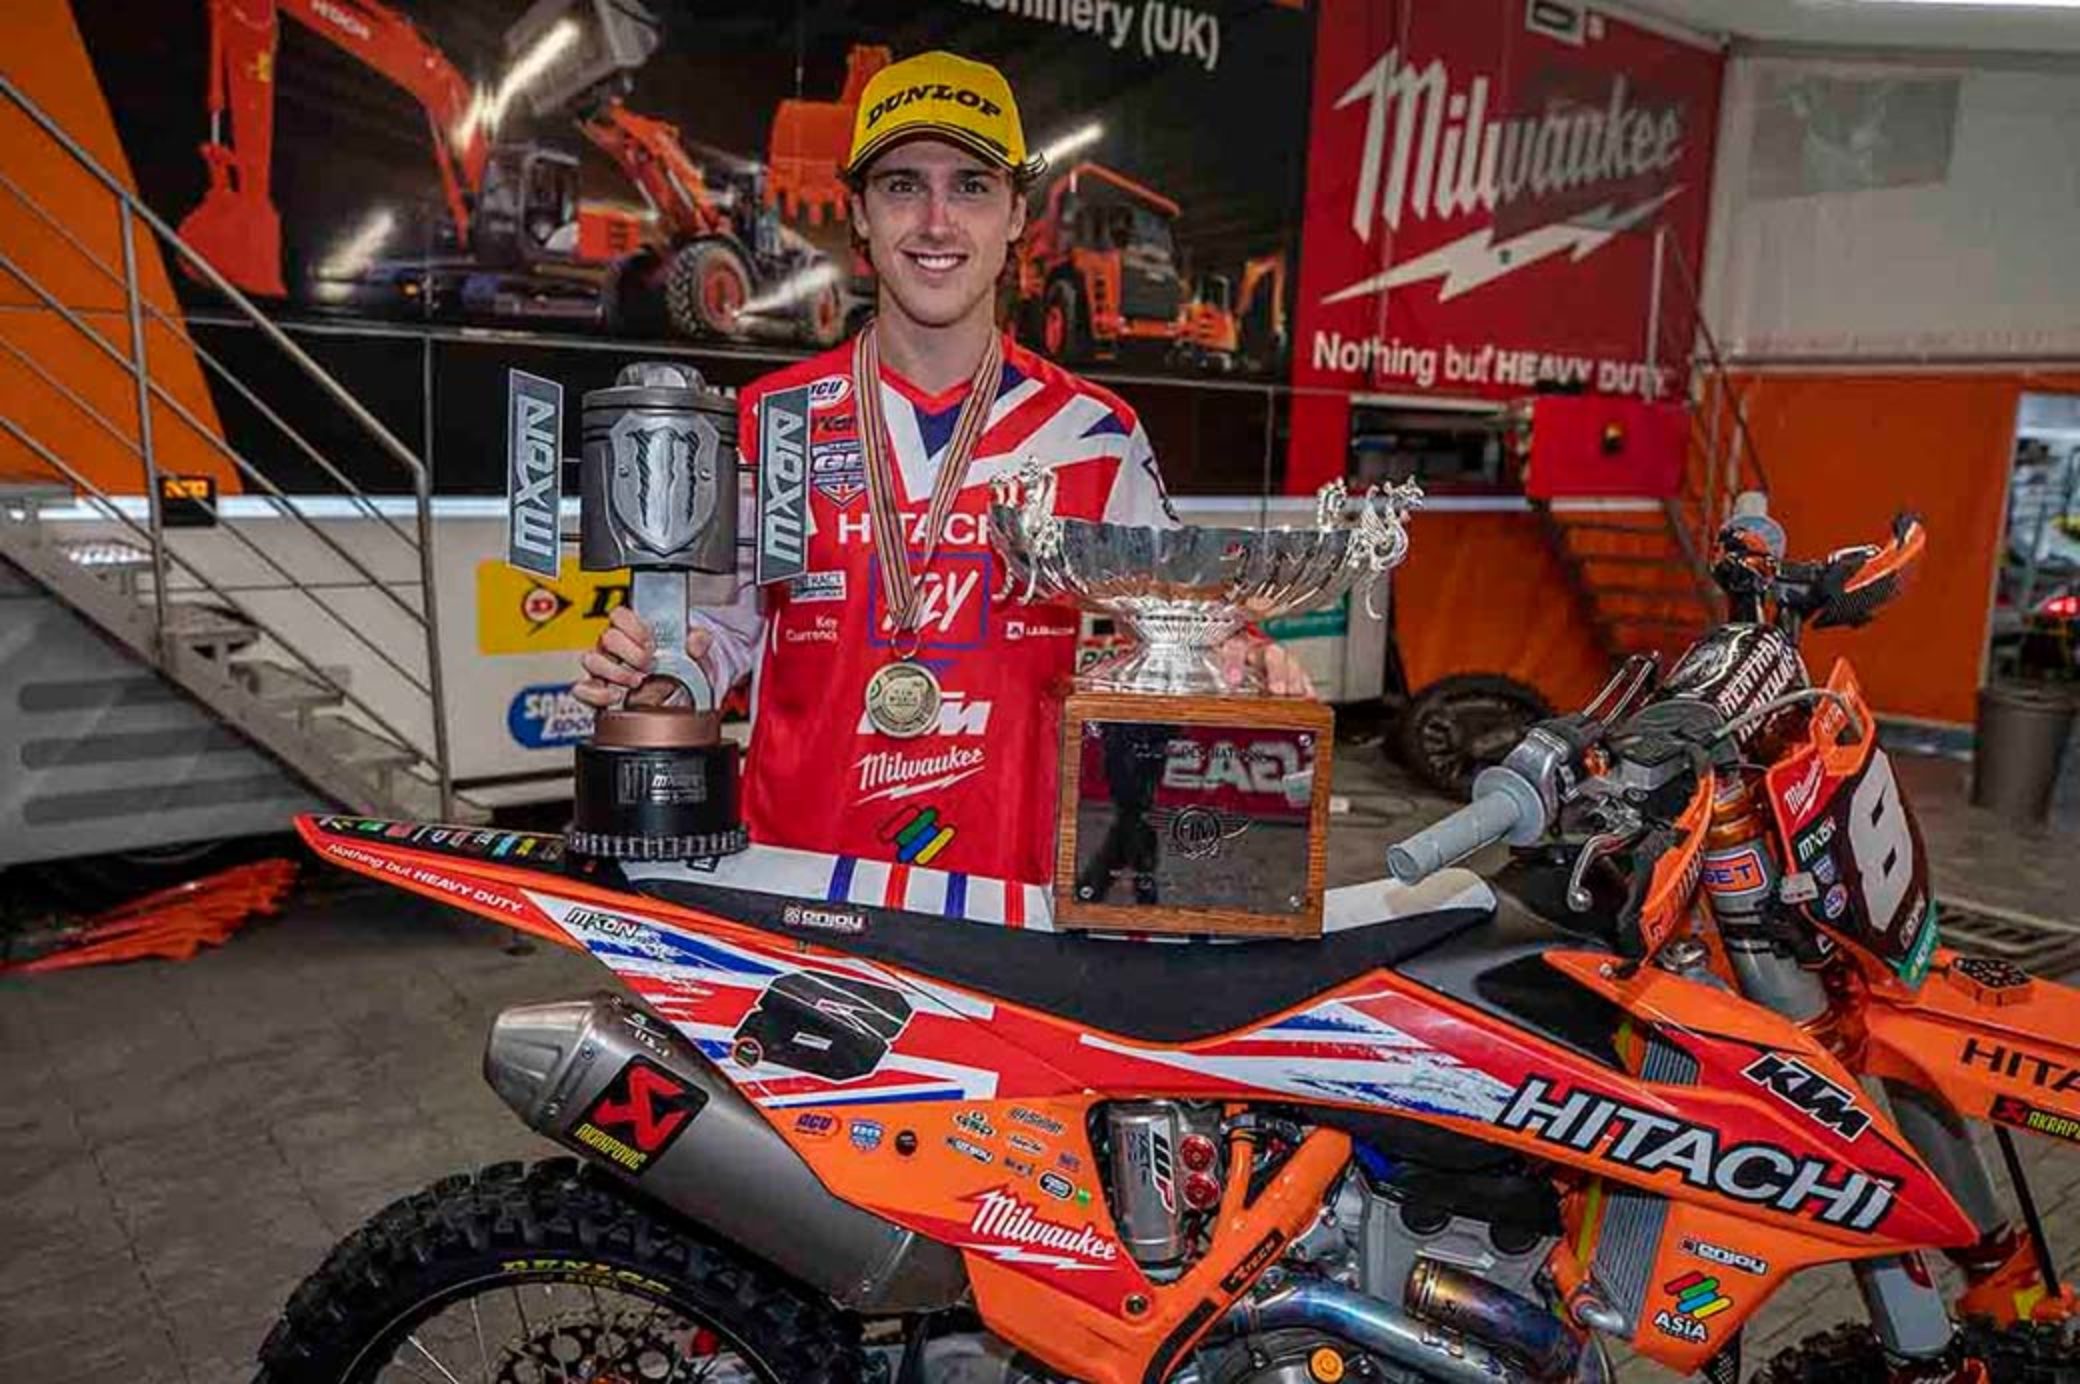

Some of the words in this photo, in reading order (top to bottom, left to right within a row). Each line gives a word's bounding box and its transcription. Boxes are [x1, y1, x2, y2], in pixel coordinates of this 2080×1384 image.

[1141, 2, 1219, 71] (UK)
[866, 84, 1003, 128] DUNLOP
[1332, 46, 1684, 245] Milwaukee
[1313, 330, 1437, 387] Nothing
[1444, 345, 1493, 384] but
[1493, 350, 1594, 386] HEAVY
[851, 746, 984, 791] Milwaukee
[327, 843, 386, 868] Nothing
[386, 860, 412, 878] but
[412, 869, 476, 897] HEAVY
[1849, 748, 1913, 932] 8
[801, 910, 864, 930] enjoy
[1746, 1055, 1870, 1140] KTM
[1503, 1077, 1898, 1230] HITACHI
[973, 1188, 1117, 1261] Milwaukee
[1653, 1311, 1708, 1341] ASIA
